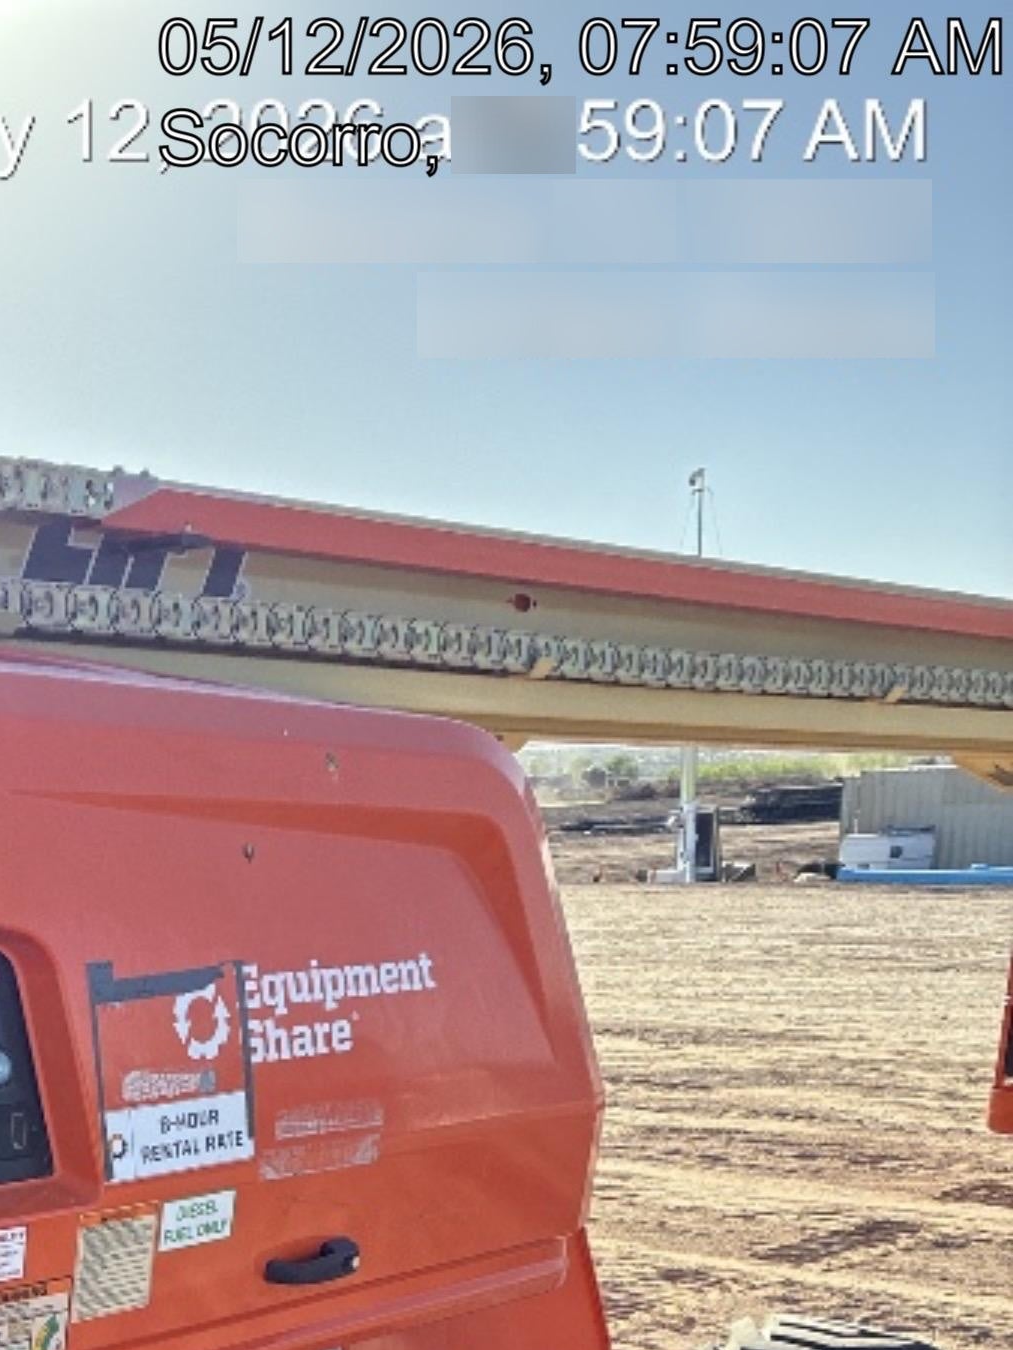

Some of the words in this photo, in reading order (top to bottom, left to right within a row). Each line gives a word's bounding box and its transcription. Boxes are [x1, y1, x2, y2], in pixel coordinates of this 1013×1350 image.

[239, 952, 437, 1016] Equipment
[242, 1011, 354, 1063] Share
[141, 1138, 202, 1165] RENTAL
[205, 1130, 244, 1152] RATE
[164, 1225, 194, 1245] FUEL
